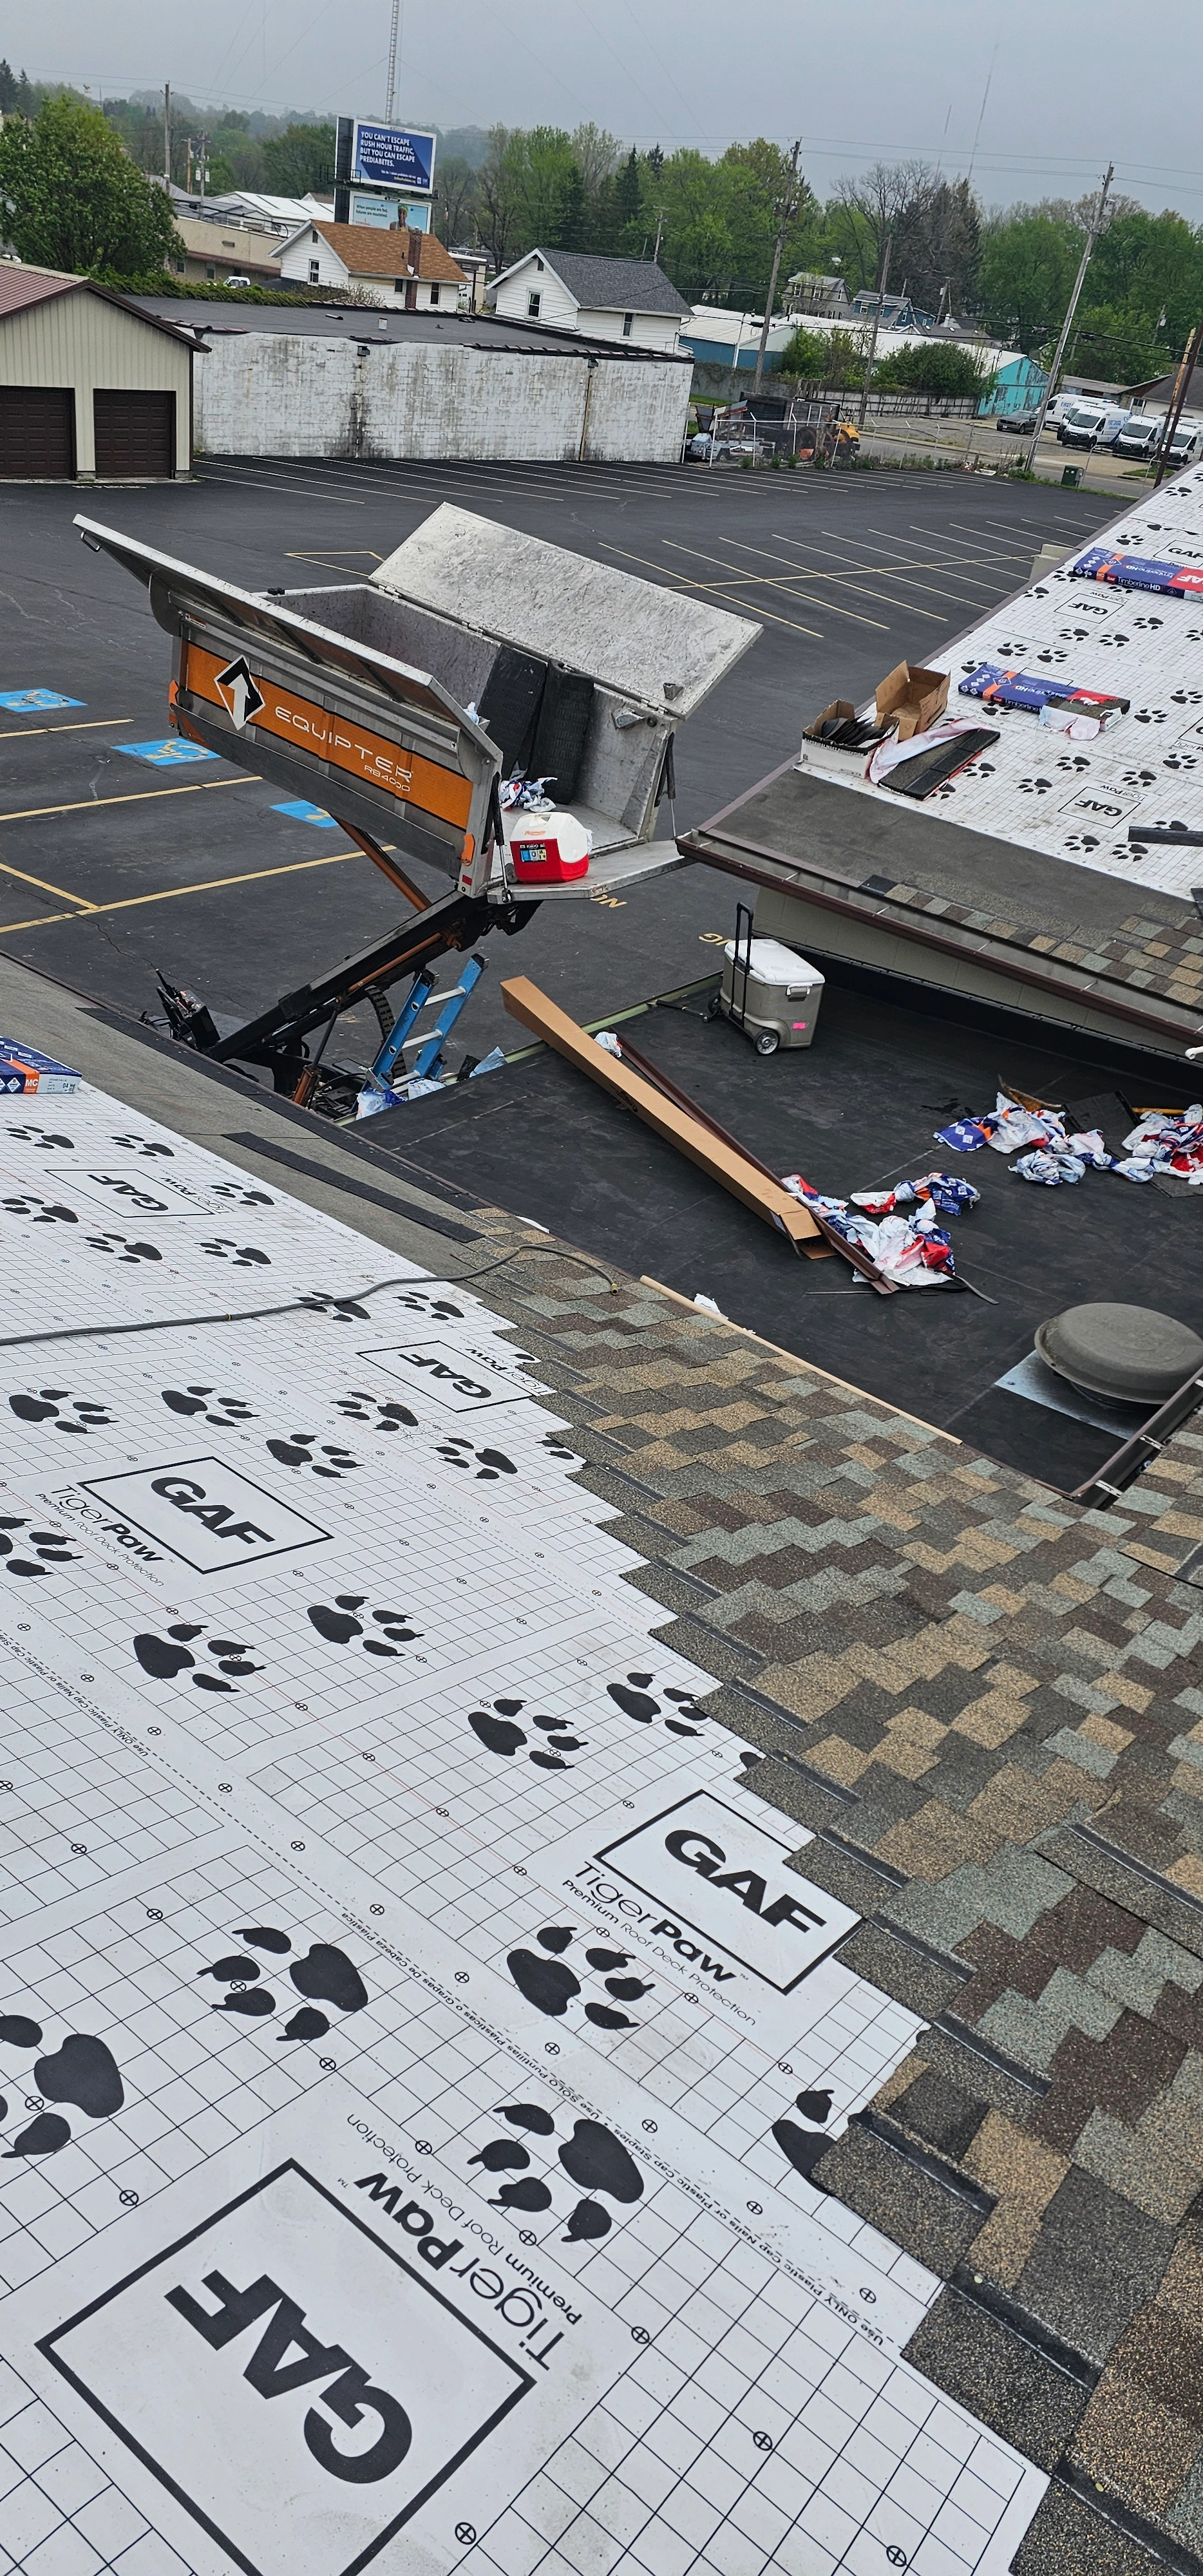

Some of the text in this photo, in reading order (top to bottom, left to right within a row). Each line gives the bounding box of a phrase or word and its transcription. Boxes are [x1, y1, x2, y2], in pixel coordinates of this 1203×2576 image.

[361, 139, 414, 155] RUSH HOUR TRAFFIC,
[391, 136, 410, 146] ESCAPE
[360, 155, 393, 166] PREDIABETES.
[371, 149, 383, 157] YOU
[384, 151, 396, 159] CAN
[396, 153, 415, 163] ESCAPE
[1117, 576, 1150, 589] Timberline
[1176, 574, 1203, 585] AF
[1068, 602, 1108, 615] GAF
[1089, 591, 1130, 604] TigerPaw
[275, 706, 412, 783] EQUIPTER
[365, 765, 410, 791] RB4000
[1100, 784, 1146, 802] TigerPaw
[1074, 799, 1122, 817] GAF
[25, 1079, 39, 1087] MC
[86, 1173, 169, 1212] GAF
[159, 1177, 230, 1215] TigerPaw
[398, 1353, 492, 1399] GAF
[464, 1348, 548, 1396] TigerPaw
[150, 1476, 276, 1545] GAF
[50, 1484, 166, 1562] TigerPaw
[35, 1493, 164, 1587] Premium Roof Deck Protection
[10, 1645, 25, 1657] Cap
[24, 1656, 48, 1676] Plastic
[55, 1681, 75, 1697] Nails
[73, 1696, 90, 1709] Cap
[88, 1708, 113, 1728] Plastic
[110, 1728, 134, 1744] ONLY
[132, 1743, 149, 1757] Use
[665, 1830, 827, 1934] GAF
[574, 1861, 737, 1982] TigerPaw
[375, 1940, 408, 1967] Cabeza
[562, 1879, 756, 2026] Premium Roof Deck Protection
[408, 1967, 422, 1978] De
[422, 1978, 455, 2005] Grapas
[463, 2011, 506, 2046] Plásticas
[506, 2045, 548, 2079] Puntillas
[580, 2102, 600, 2120] Use
[613, 2128, 652, 2161] Staples
[654, 2159, 675, 2178] Cap
[677, 2177, 713, 2210] Plastic
[346, 2114, 583, 2325] Premium Roof Deck Protection
[714, 2208, 727, 2220] or
[729, 2221, 757, 2244] Nails
[759, 2244, 781, 2264] Cap
[353, 2172, 565, 2371] TigerPaw
[784, 2263, 823, 2297] Plastic
[824, 2295, 858, 2324] ONLY
[860, 2323, 884, 2346] Use
[164, 2269, 413, 2485] GAF
